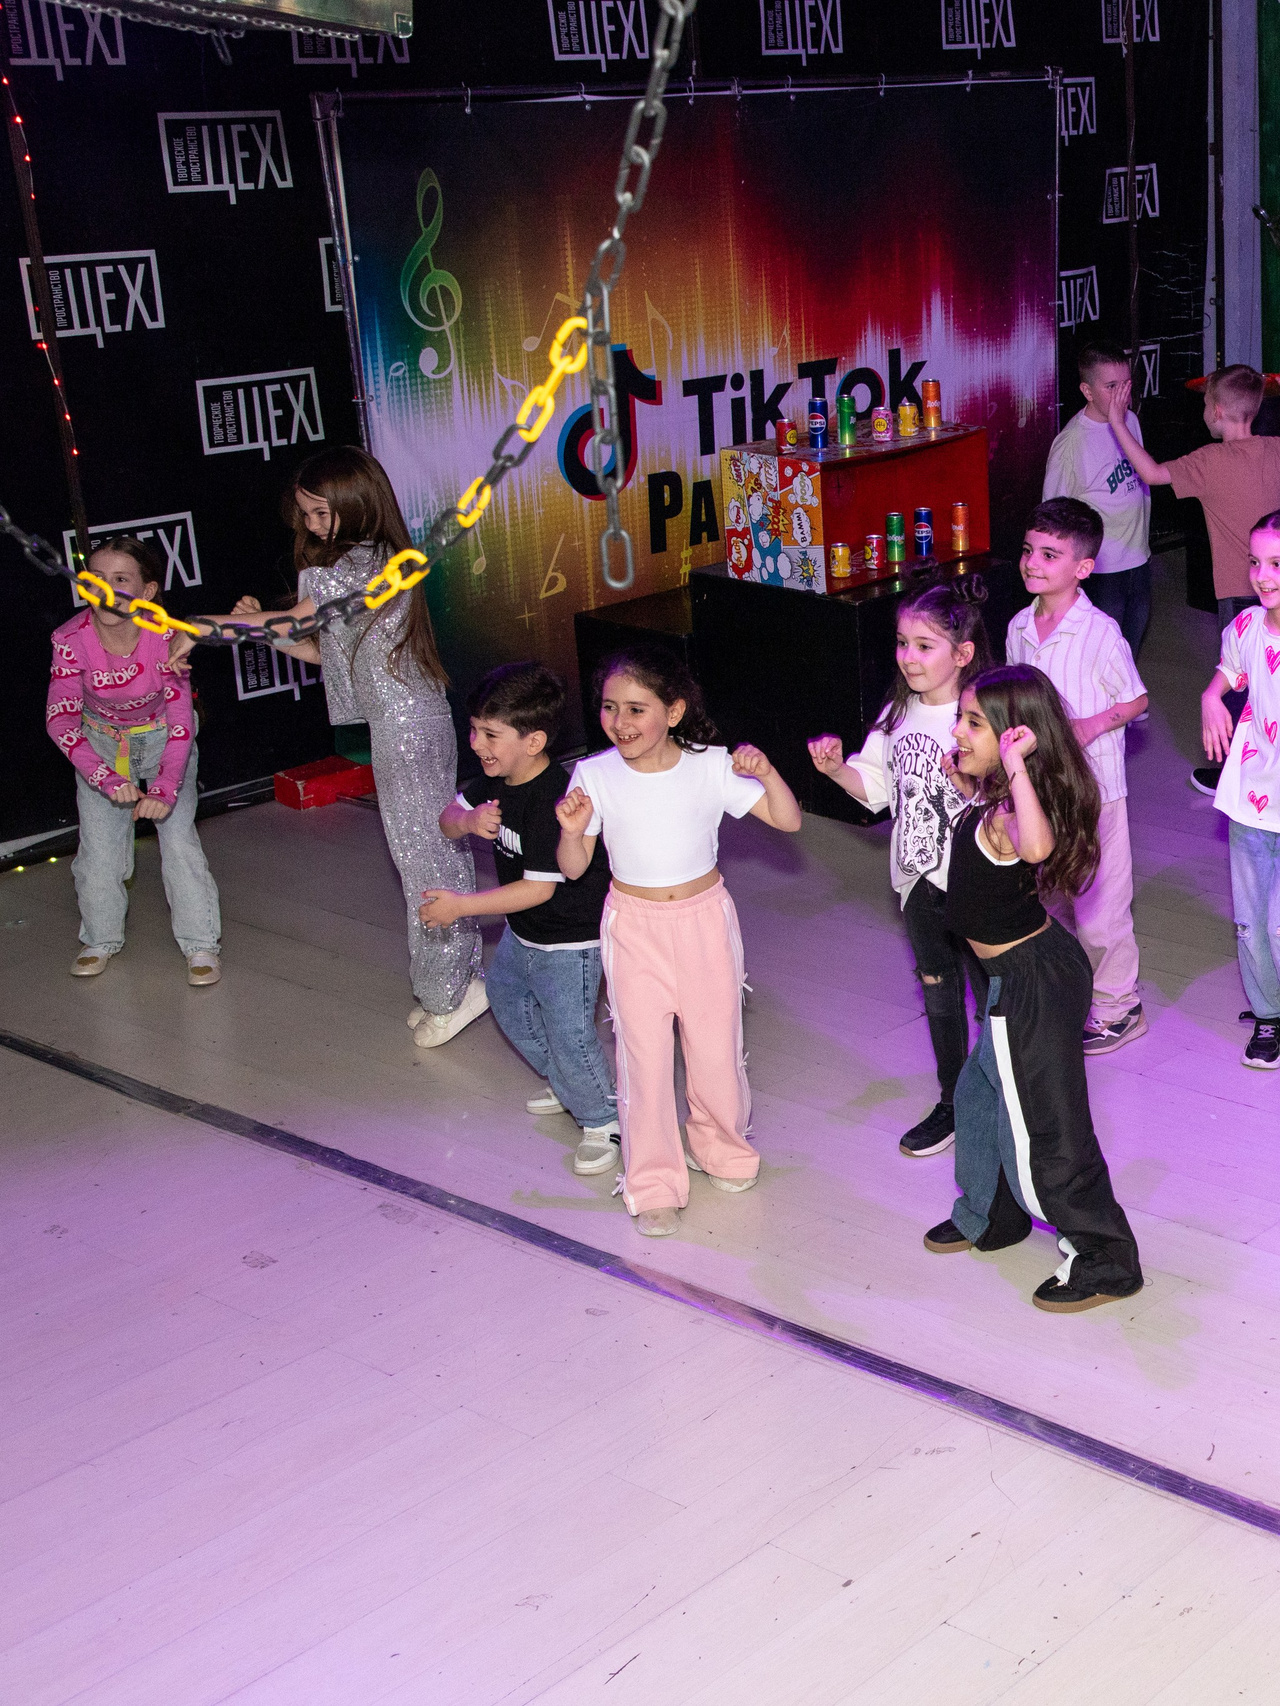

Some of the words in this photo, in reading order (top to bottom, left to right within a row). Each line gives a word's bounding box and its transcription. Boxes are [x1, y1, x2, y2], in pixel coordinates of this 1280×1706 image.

[5, 0, 23, 54] ПРОСТРАНСТВ
[558, 11, 571, 51] ТВОРЧЕСКОЕ
[567, 1, 581, 52] ПРОСТРАНСТВО
[579, 0, 644, 73] ЦЕХ
[784, 0, 836, 67] ЦЕХ
[963, 0, 1009, 60] ЦЕХ
[173, 137, 188, 182] ТВОРЧЕСКОЕ
[185, 126, 202, 182] ПРОСТРАНСТВО
[202, 123, 285, 205] ЦЕХ
[48, 270, 68, 327] ПРОСТРАНСТВО
[64, 263, 153, 348] ЦЕХ
[210, 401, 225, 444] ТВОРЧЕСКОЕ
[222, 390, 238, 443] ПРОСТРАНСТВО
[237, 380, 315, 462] ЦЕХ
[1106, 458, 1137, 495] BOS
[647, 471, 721, 554] PA
[92, 662, 139, 689] Barbie
